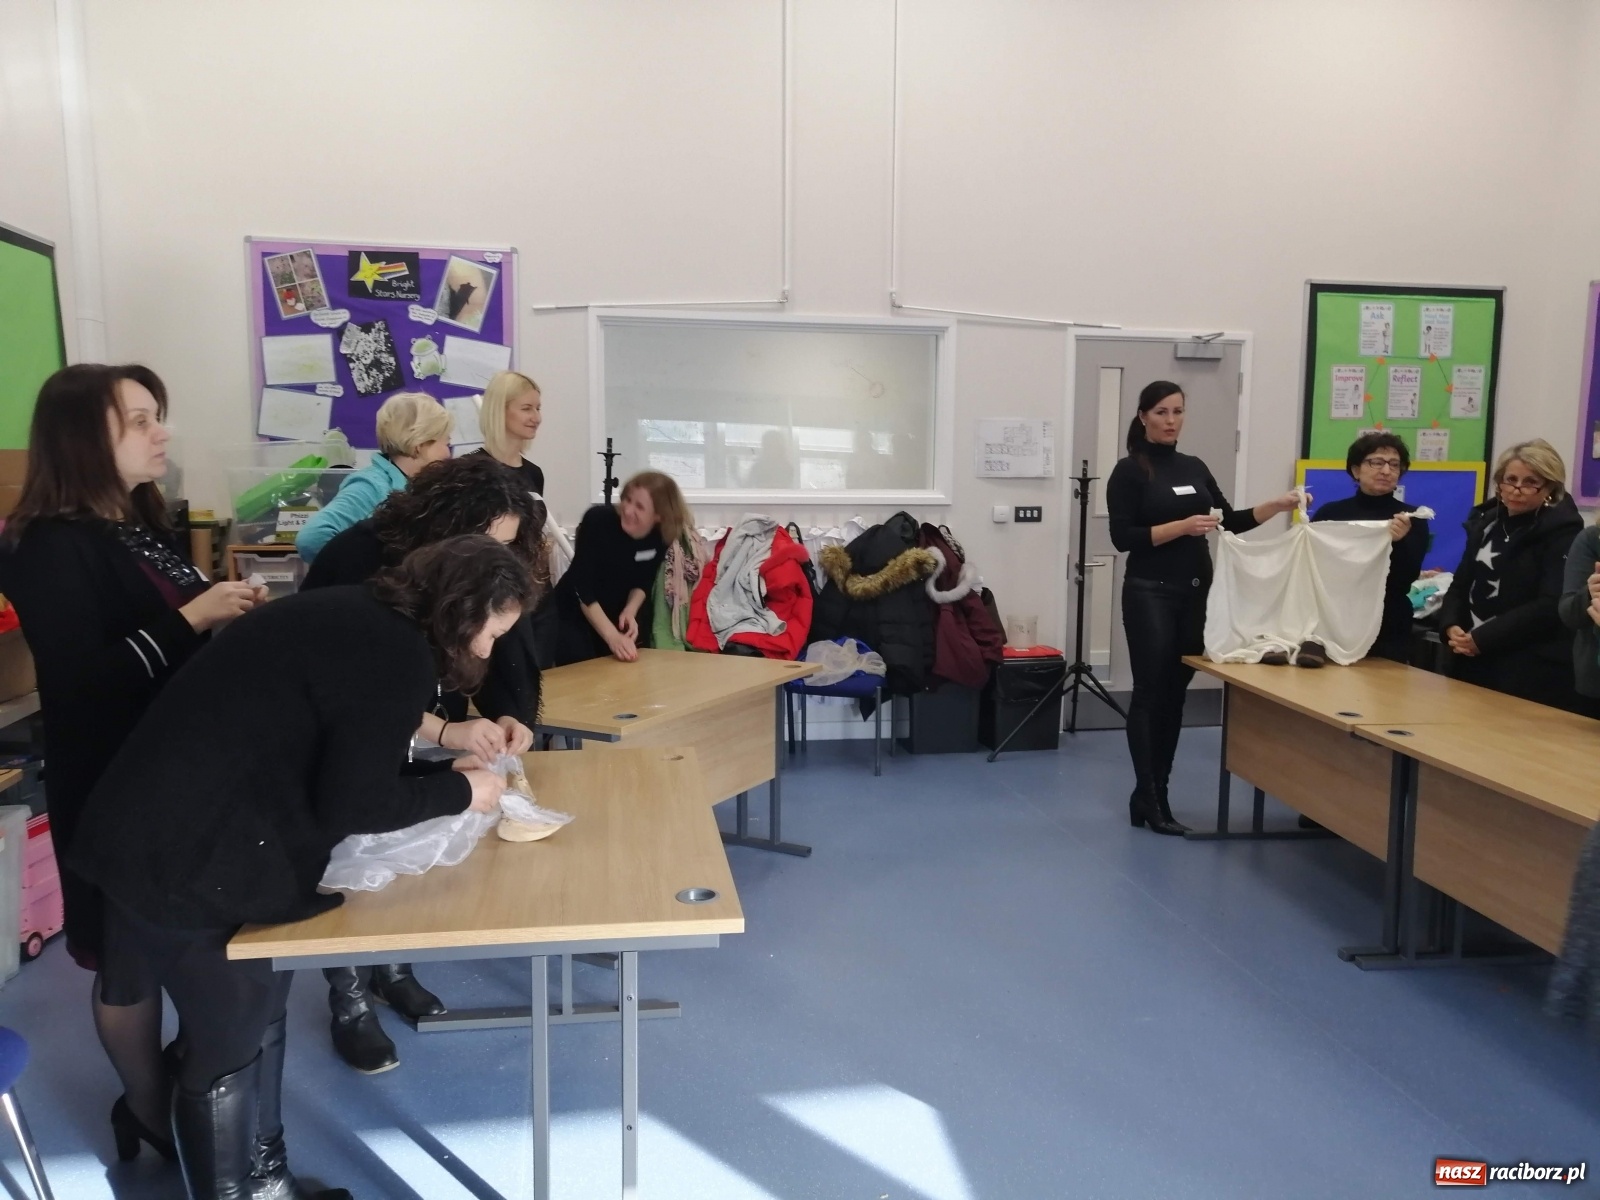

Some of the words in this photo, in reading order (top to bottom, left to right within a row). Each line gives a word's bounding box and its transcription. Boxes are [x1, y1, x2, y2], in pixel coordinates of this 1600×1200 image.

[391, 279, 415, 291] Bright
[374, 289, 395, 298] Stars
[395, 290, 421, 301] Nursery
[1370, 311, 1385, 320] Ask
[1334, 374, 1364, 382] Improve
[1392, 374, 1418, 384] Reflect
